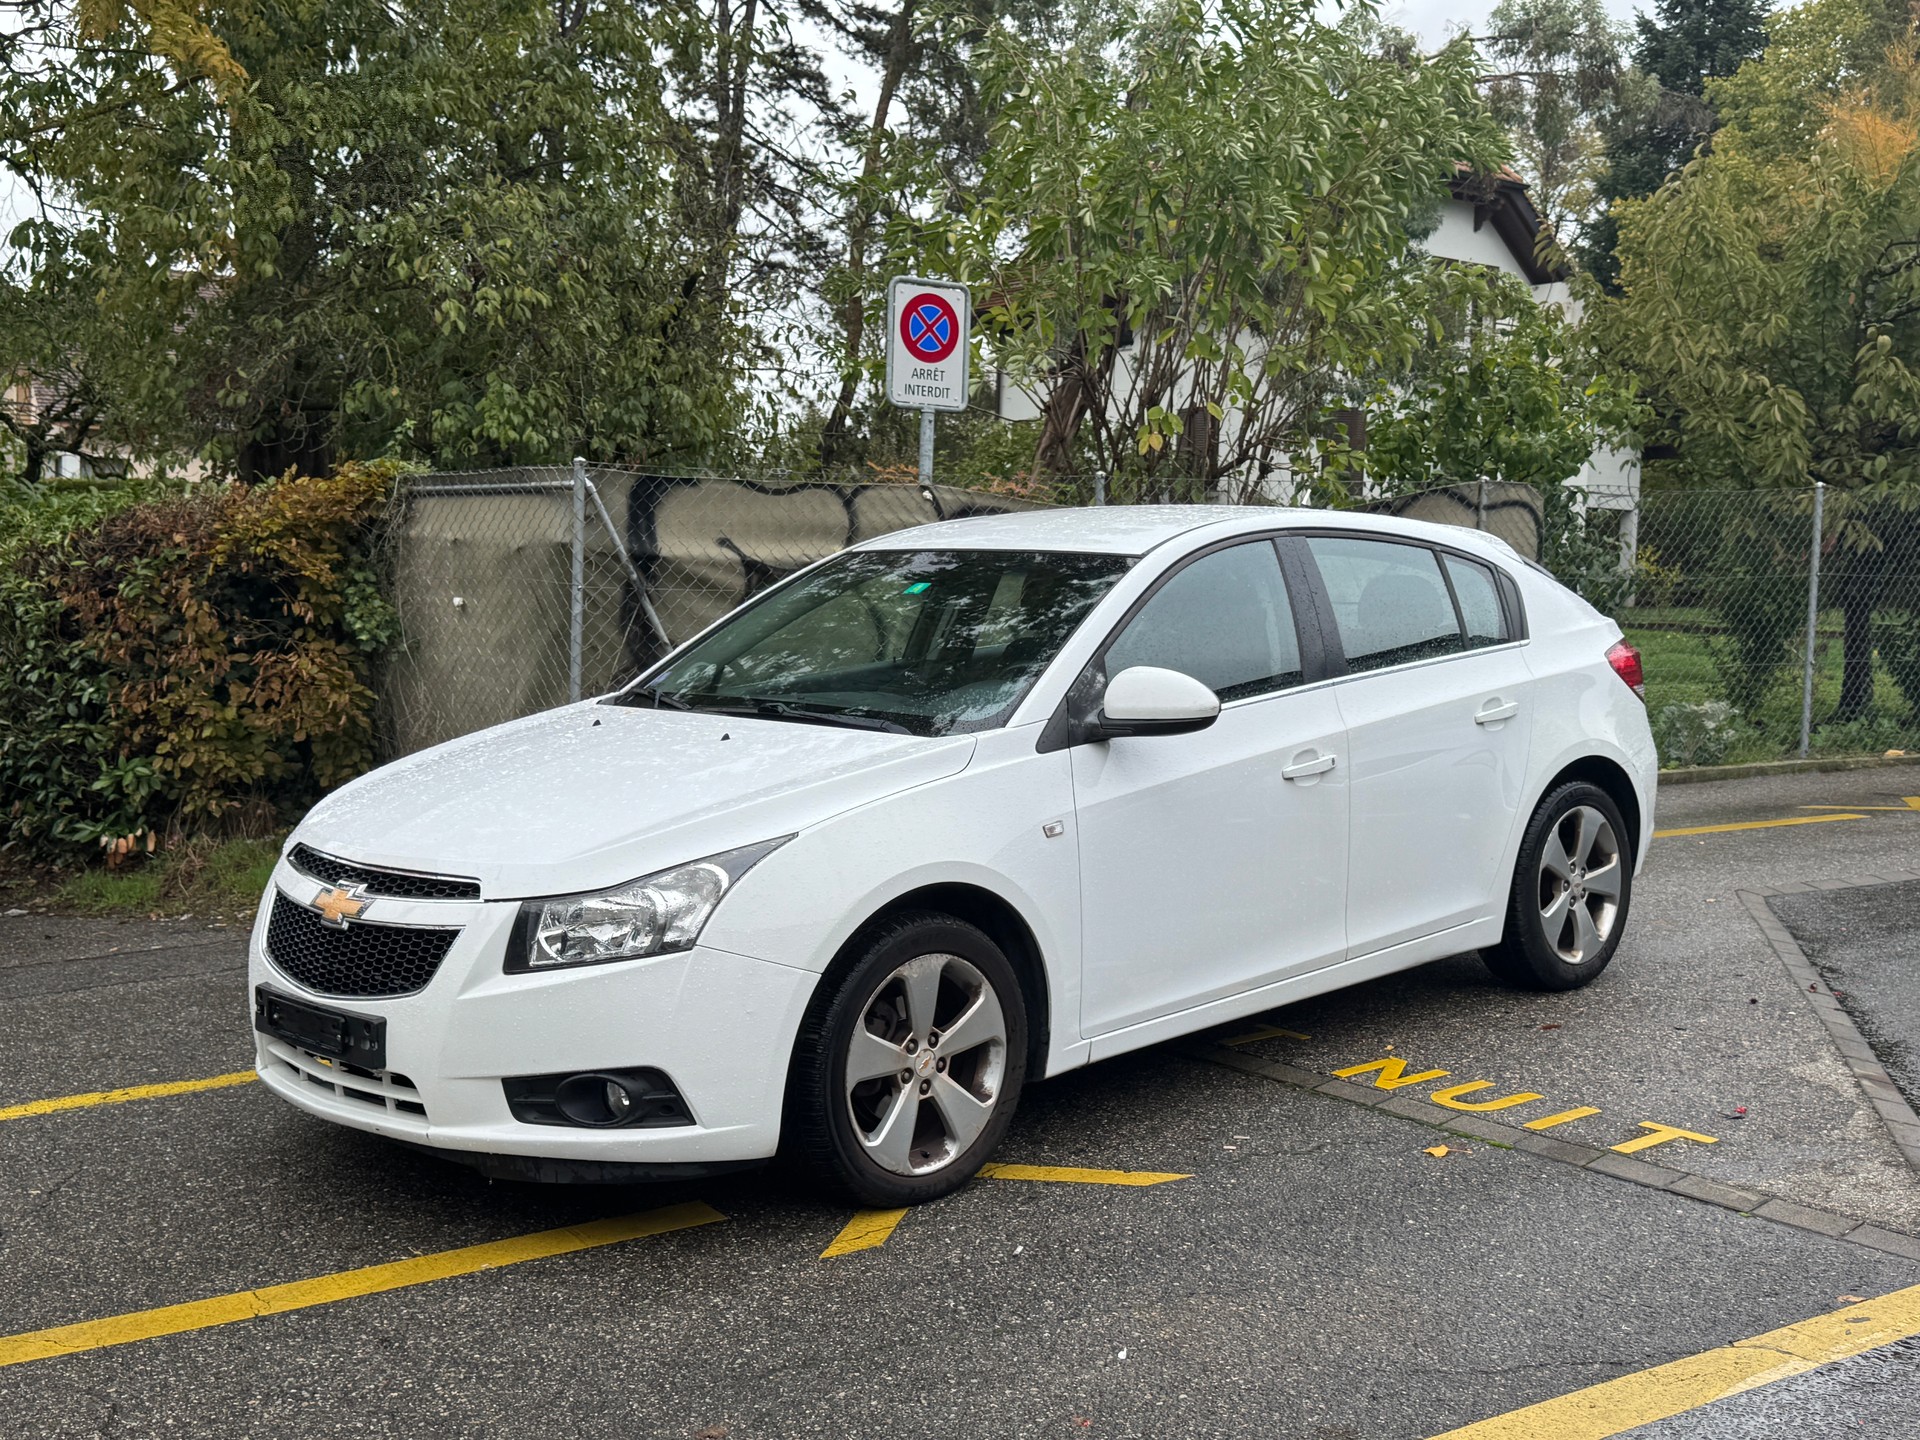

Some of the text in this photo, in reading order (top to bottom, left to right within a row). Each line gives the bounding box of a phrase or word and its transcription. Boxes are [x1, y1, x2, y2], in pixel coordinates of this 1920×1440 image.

[911, 367, 946, 382] ARRÊT
[904, 383, 950, 399] INTERDIT
[1330, 1056, 1719, 1154] NUIT
